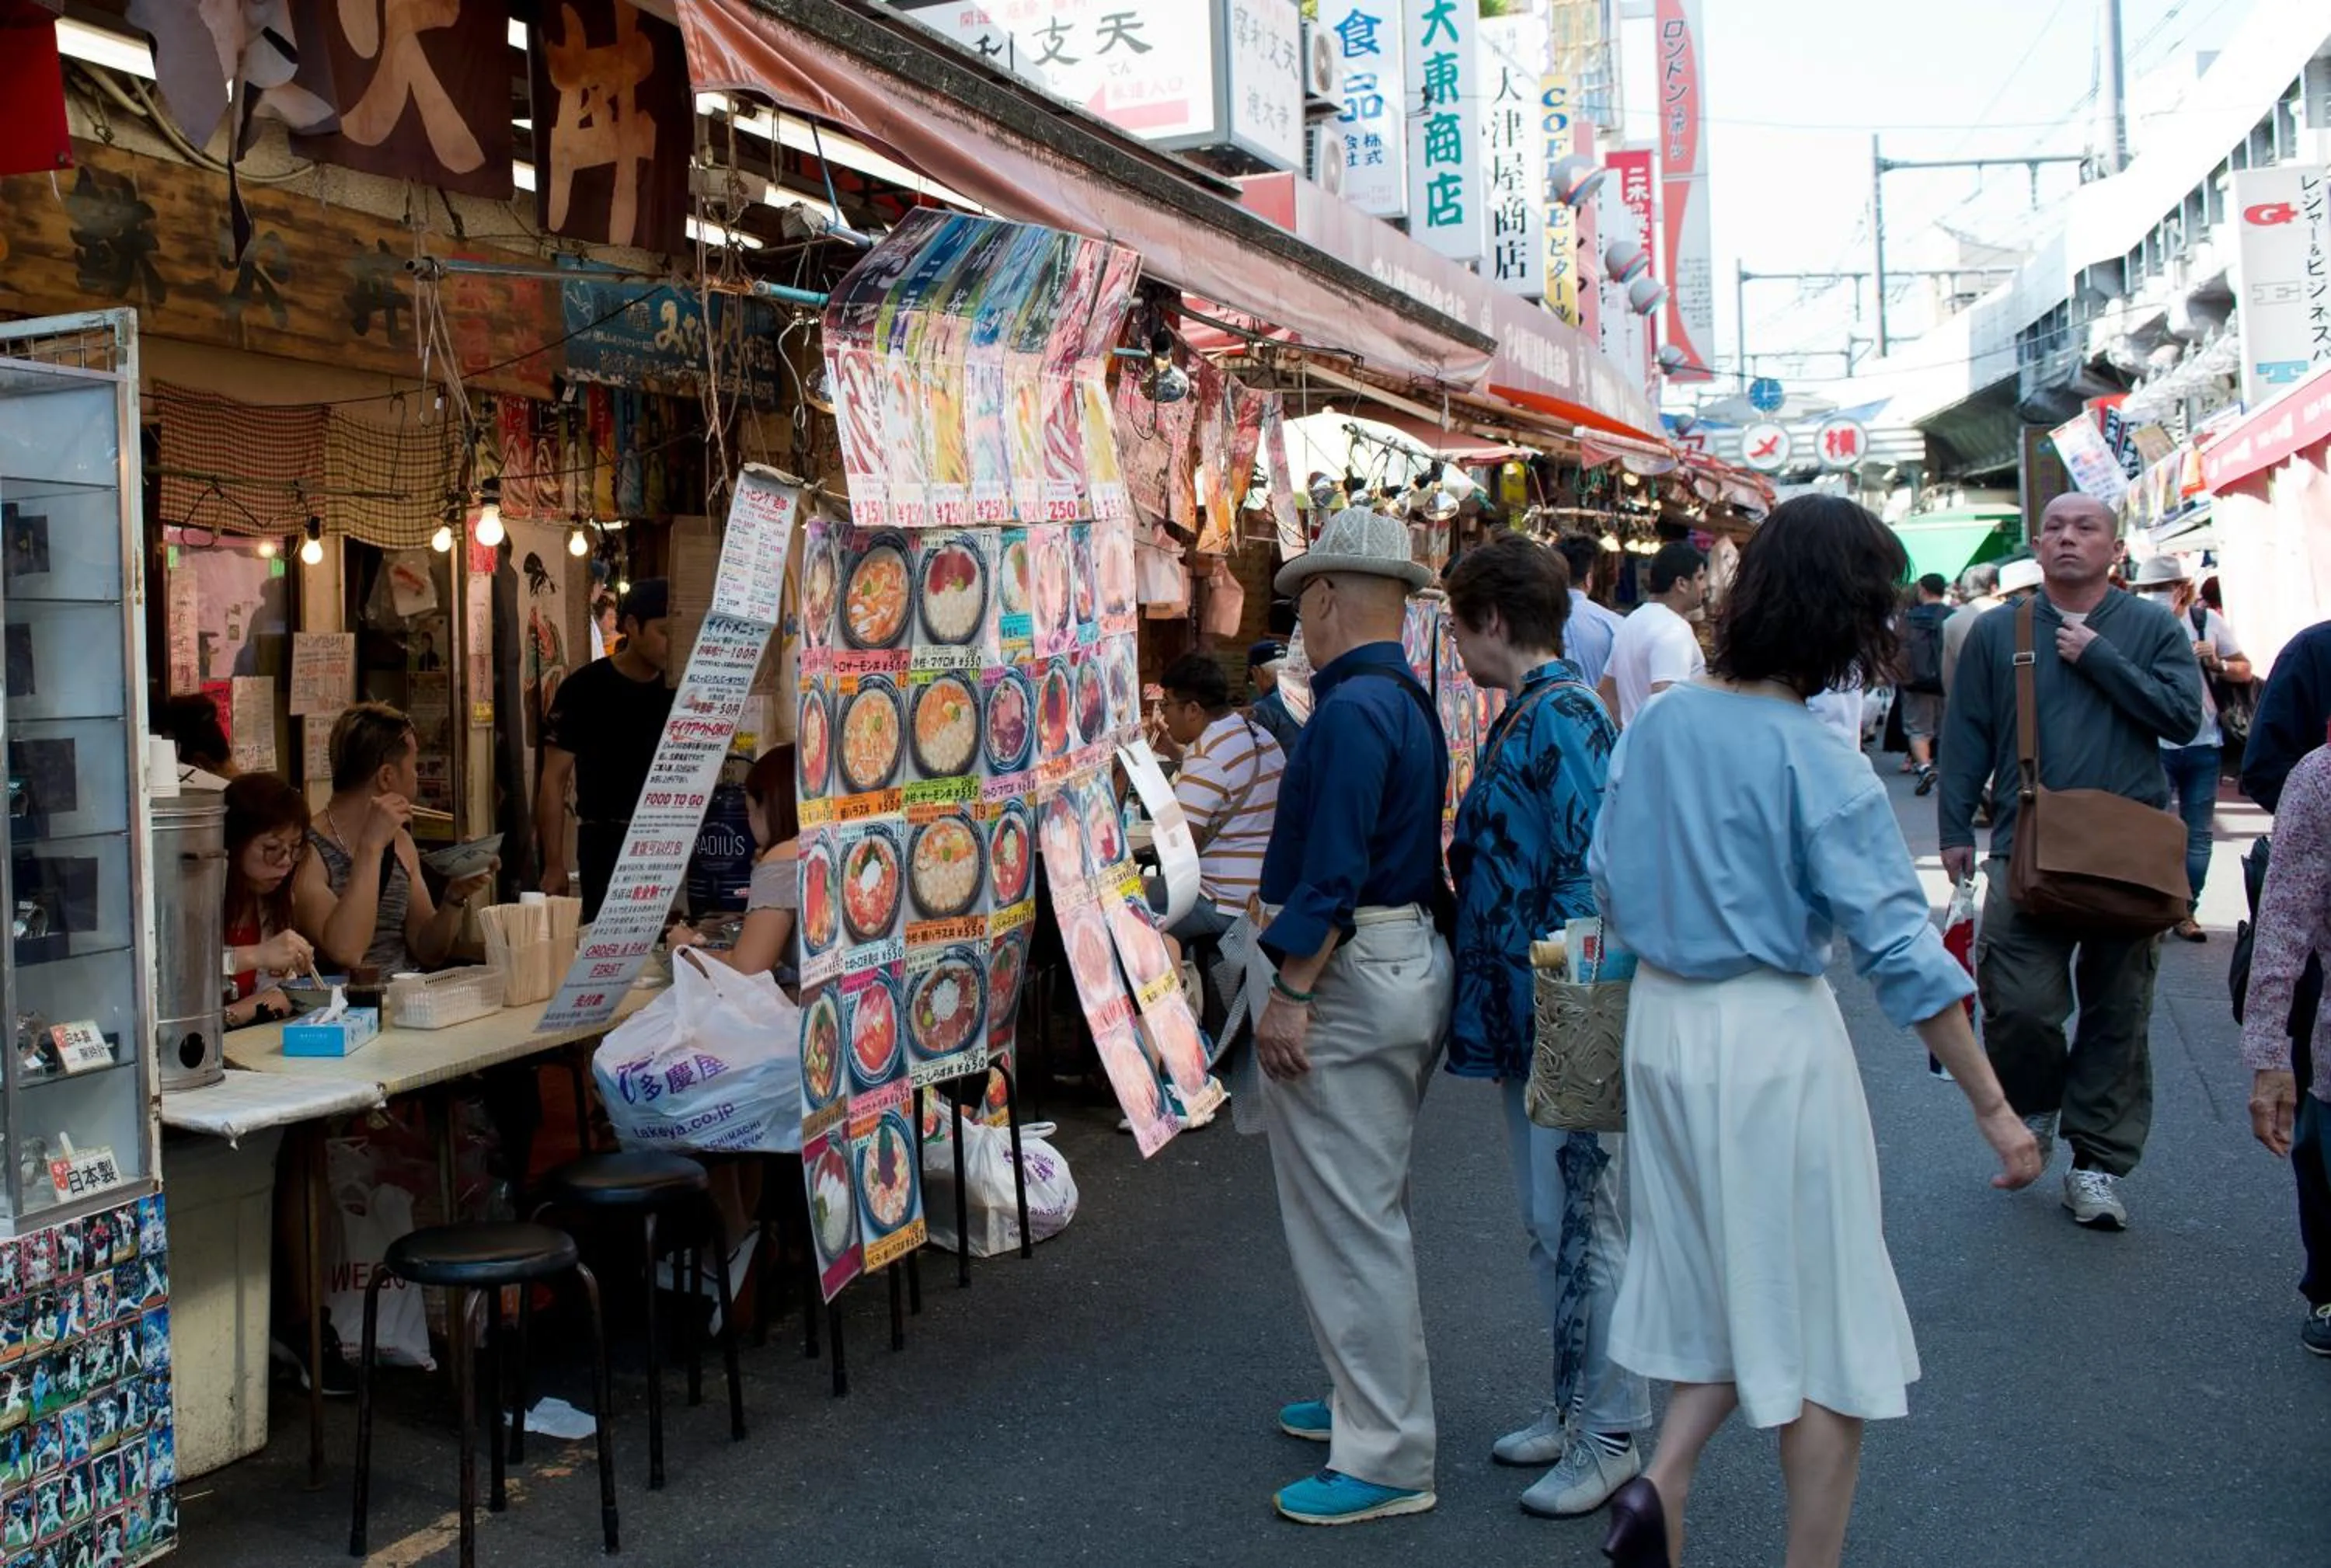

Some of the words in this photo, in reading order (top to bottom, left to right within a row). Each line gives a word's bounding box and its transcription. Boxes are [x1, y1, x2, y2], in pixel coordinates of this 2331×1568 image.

[1333, 9, 1383, 122] 食品
[1421, 0, 1464, 227] 大東商店
[644, 793, 671, 805] FOOD
[673, 794, 687, 805] TO
[688, 795, 704, 806] GO
[634, 1102, 735, 1139] takeya.co.jp
[68, 1155, 117, 1194] 日本製
